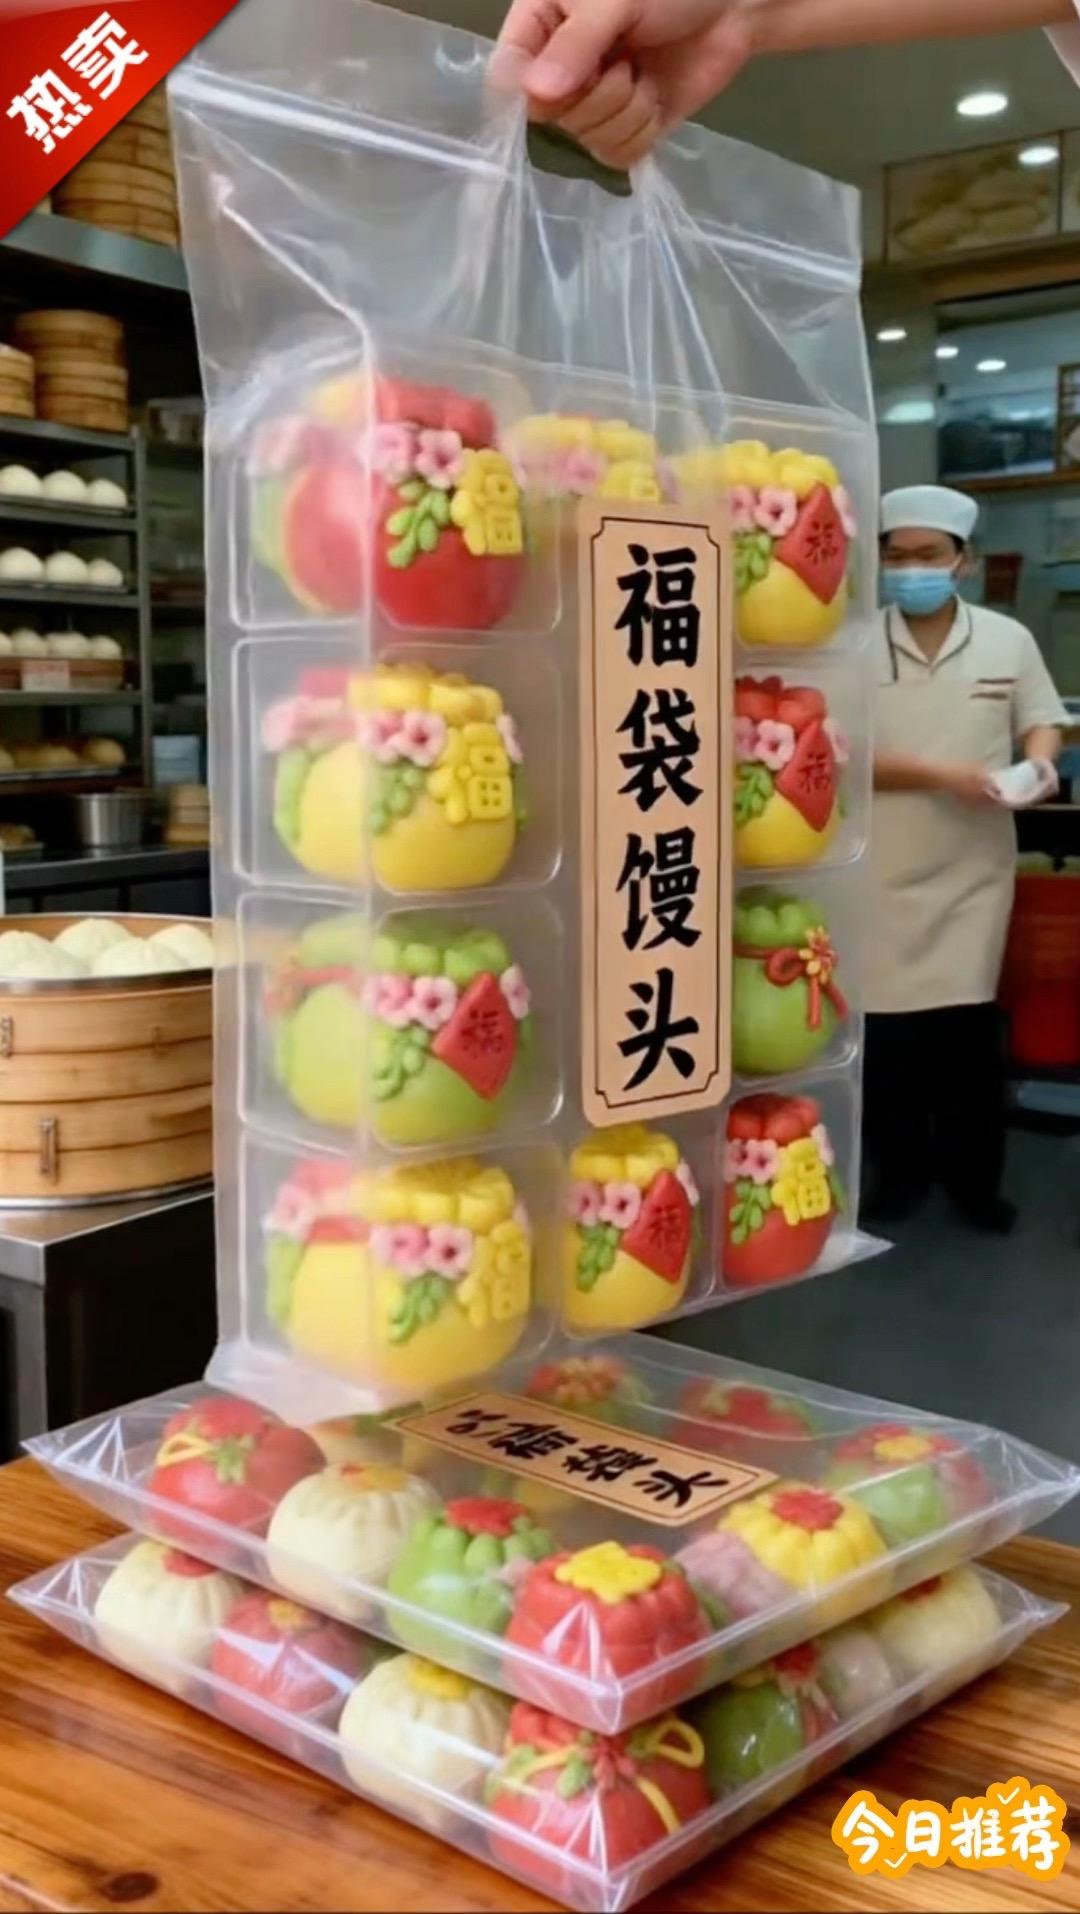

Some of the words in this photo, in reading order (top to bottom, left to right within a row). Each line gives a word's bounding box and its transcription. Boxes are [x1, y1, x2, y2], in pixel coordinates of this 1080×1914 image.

[805, 519, 838, 565] 福
[797, 752, 827, 793] 福
[614, 543, 704, 1091] 福袋馒头
